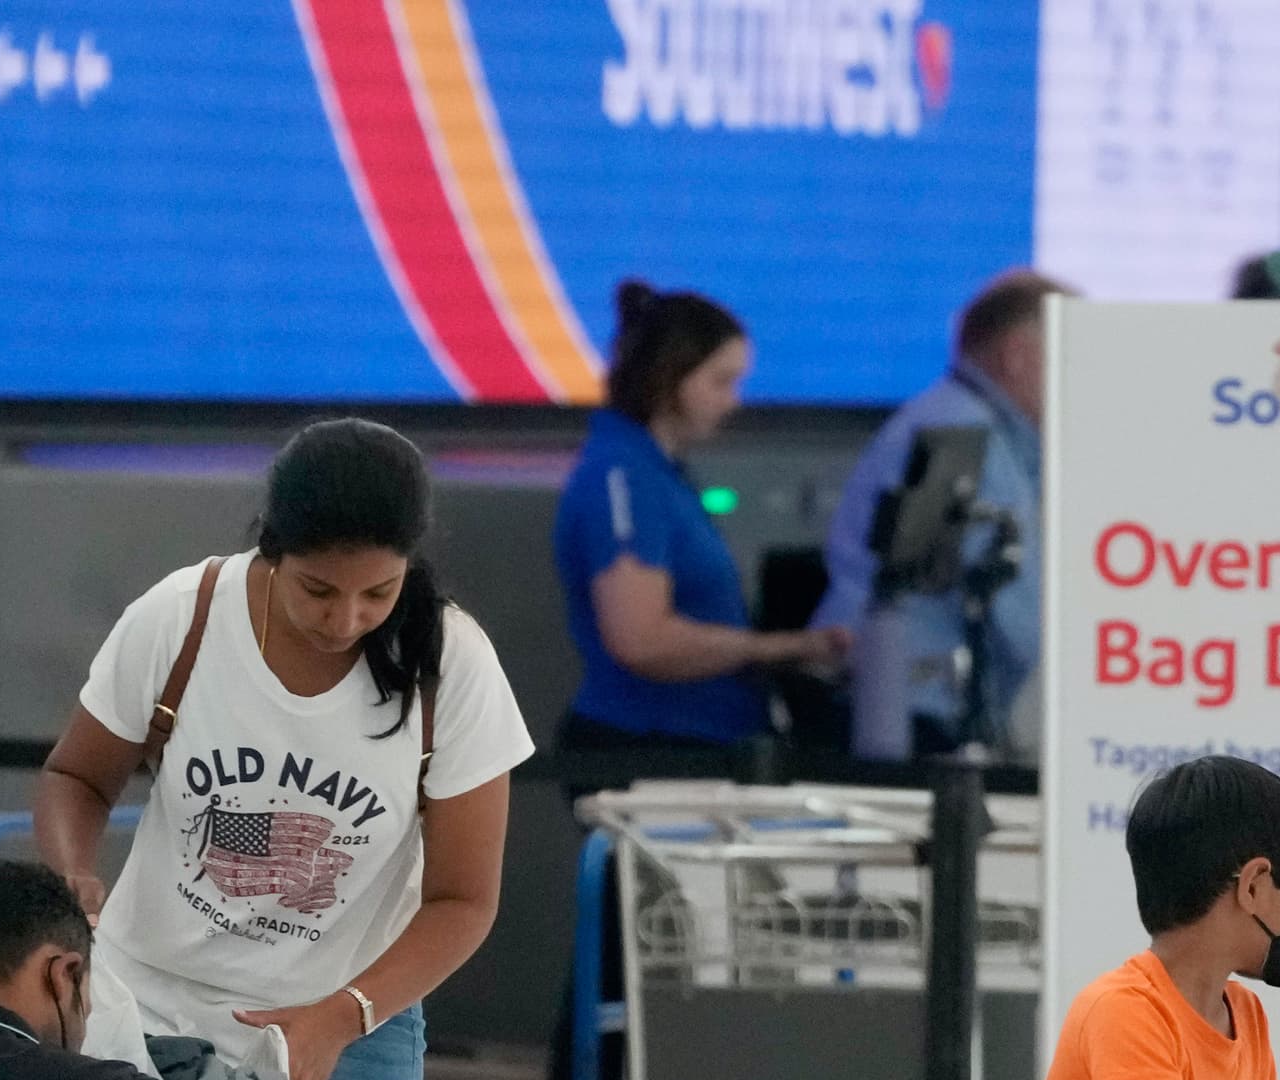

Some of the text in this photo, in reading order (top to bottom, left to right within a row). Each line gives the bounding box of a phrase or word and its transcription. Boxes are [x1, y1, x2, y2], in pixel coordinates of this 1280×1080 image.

[1096, 620, 1236, 708] Bag
[186, 747, 386, 828] OLD NAVY
[332, 834, 370, 846] 2021
[177, 882, 234, 931] AMERICA
